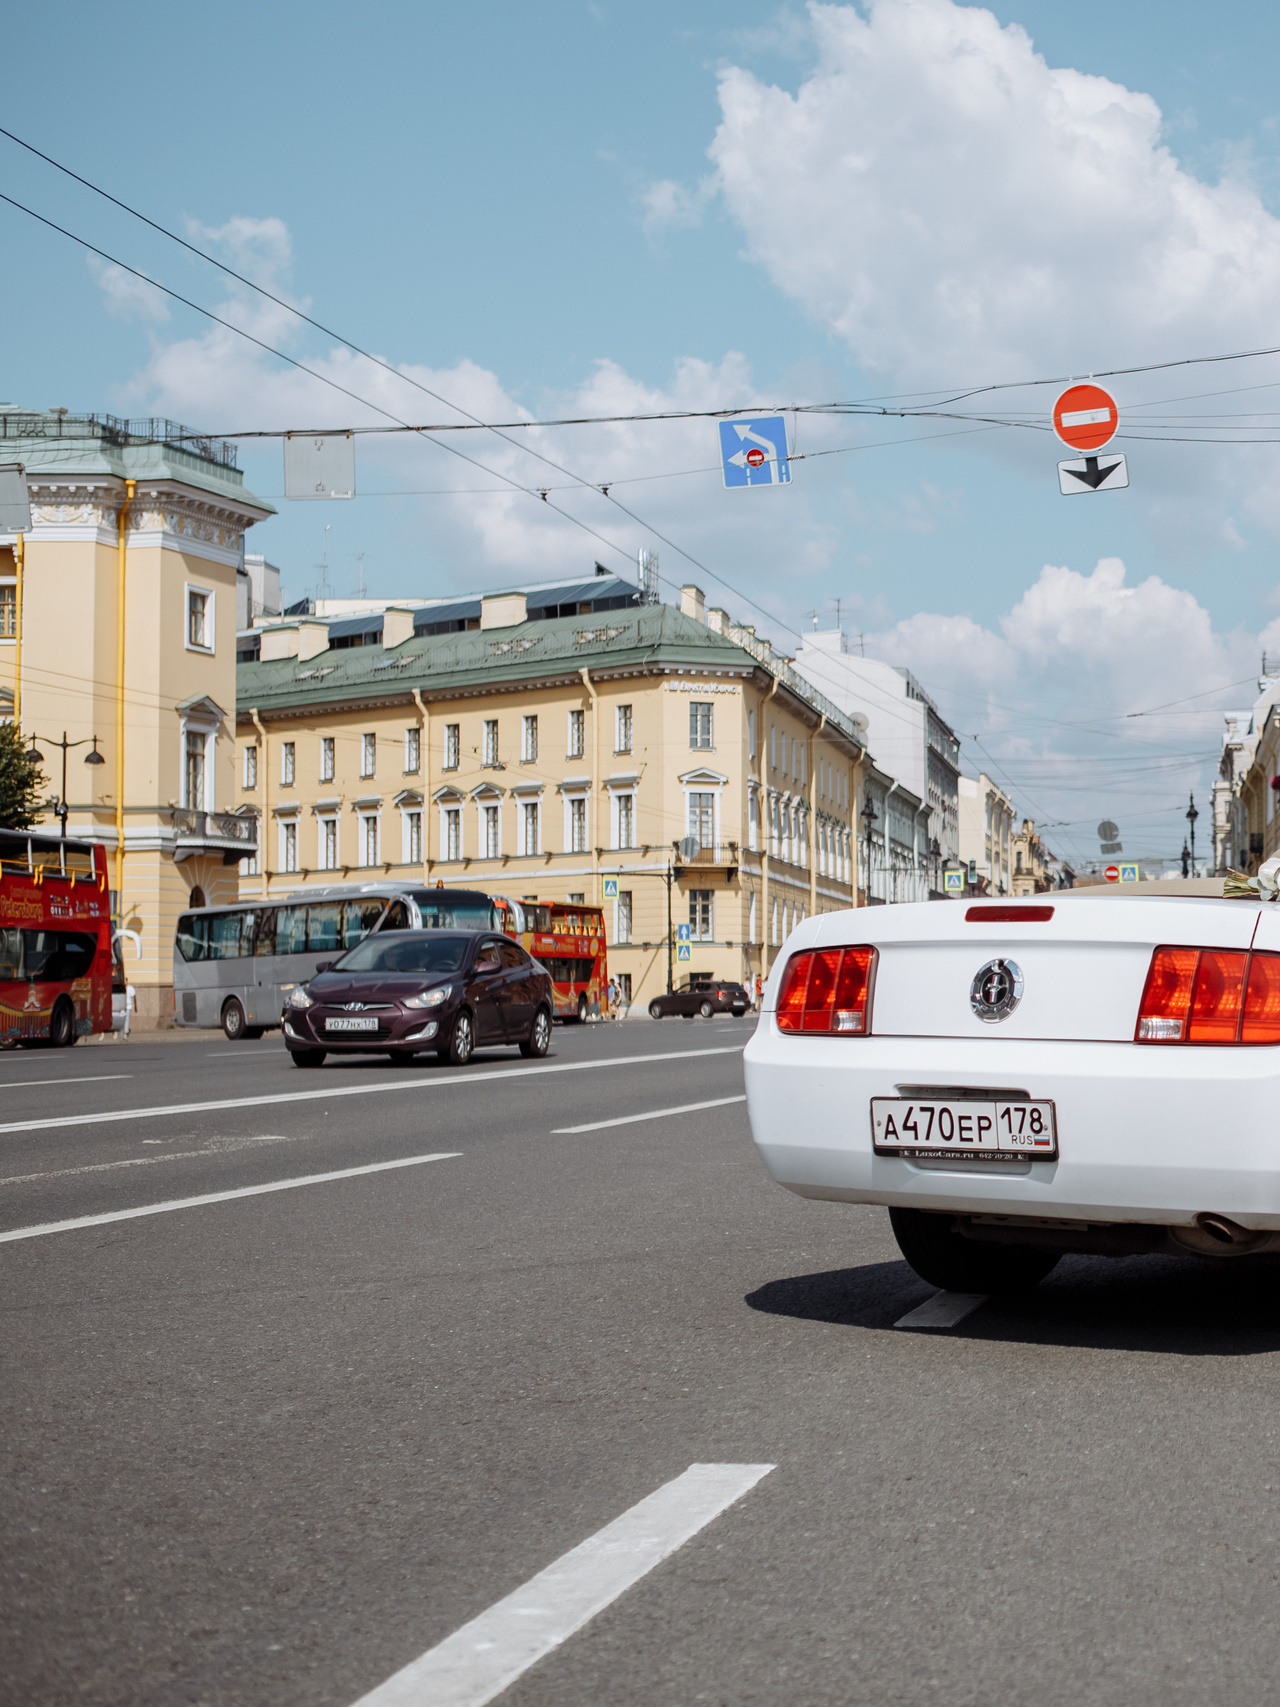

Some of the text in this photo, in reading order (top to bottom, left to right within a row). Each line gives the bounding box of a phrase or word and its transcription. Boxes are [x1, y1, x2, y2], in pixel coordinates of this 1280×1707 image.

[884, 1106, 1044, 1143] А470ЕР 178
[1011, 1134, 1033, 1145] RUS
[915, 1150, 974, 1159] LuxoCars.ru
